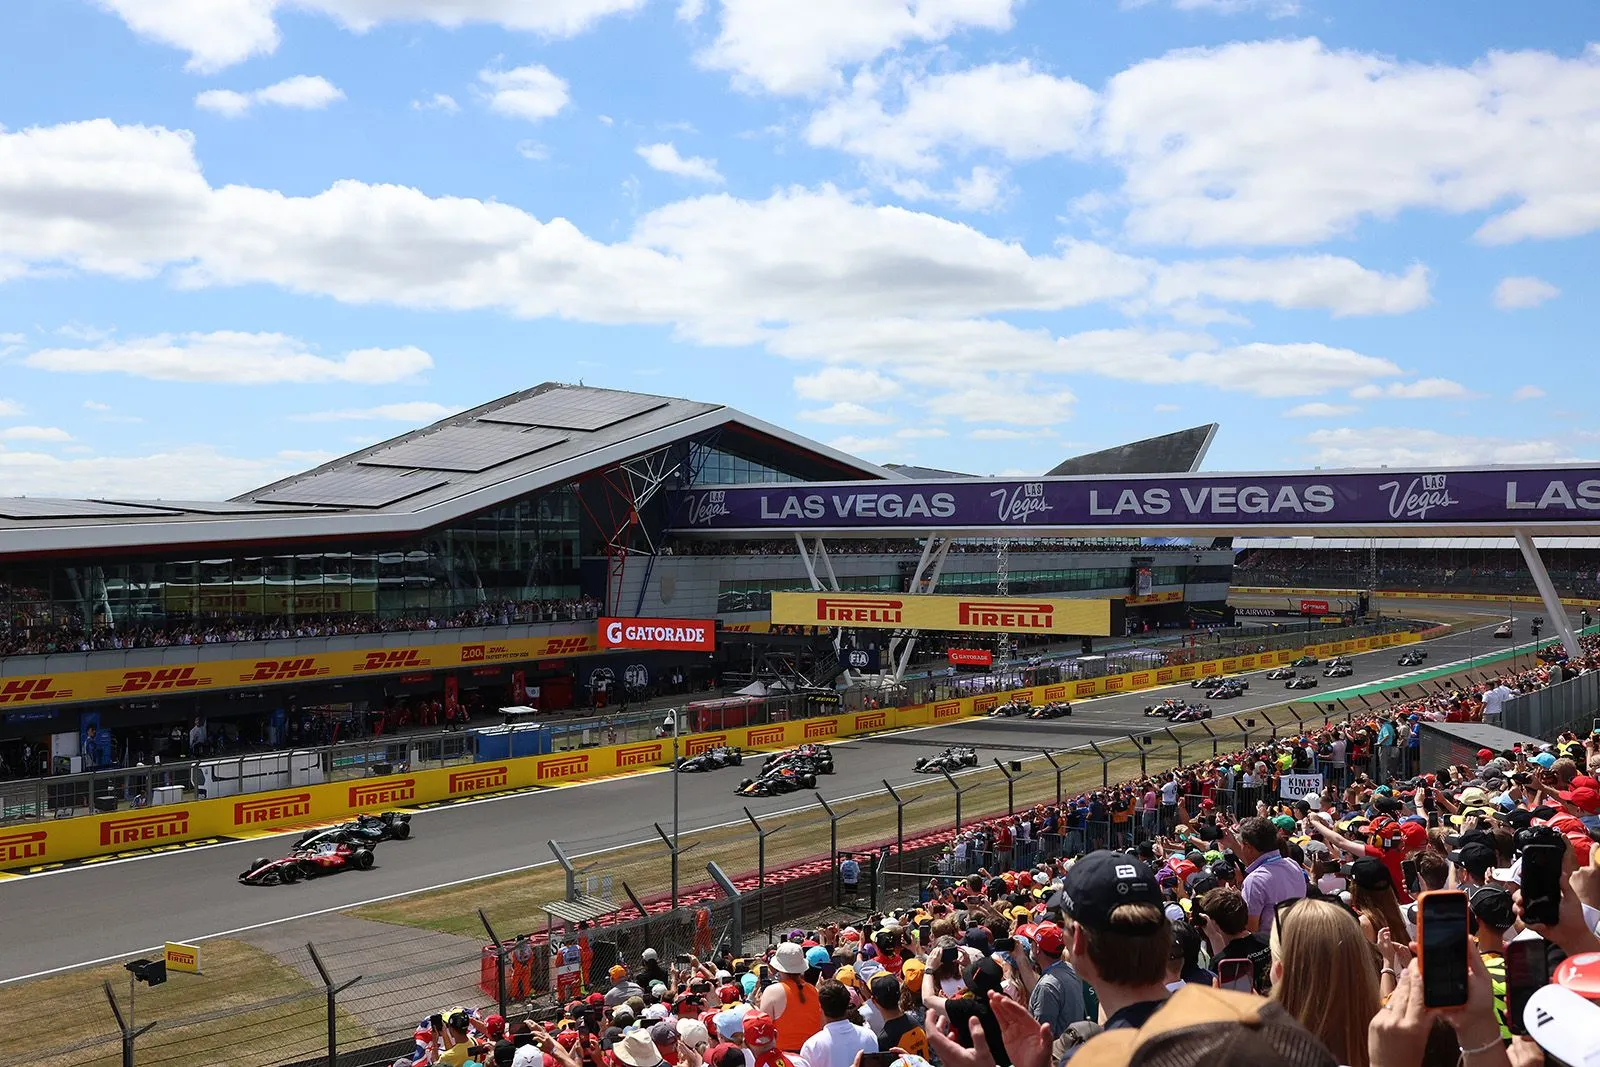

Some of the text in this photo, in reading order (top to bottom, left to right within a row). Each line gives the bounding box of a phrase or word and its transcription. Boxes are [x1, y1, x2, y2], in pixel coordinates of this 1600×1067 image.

[1025, 483, 1043, 496] LAS
[1424, 475, 1445, 490] LAS
[1505, 479, 1600, 510] LAS
[684, 491, 730, 525] Vegas
[710, 491, 725, 503] LAS
[760, 492, 956, 519] LAS VEGAS
[990, 486, 1053, 522] Vegas
[1090, 484, 1335, 516] LAS VEGAS
[1378, 478, 1459, 519] Vegas
[817, 598, 903, 623] PIRELLI
[959, 602, 1054, 628] PIRELLI
[546, 637, 589, 655] DHL
[625, 626, 705, 643] GATORADE
[252, 658, 318, 681] DHL
[364, 650, 421, 671] DHL
[0, 678, 57, 703] HL
[121, 667, 199, 692] DHL
[855, 712, 886, 730] PIRELLI
[934, 702, 960, 718] PIRELLI
[747, 727, 784, 746] PIRELLI
[804, 719, 838, 738] PIRELLI
[537, 755, 589, 780] PIRELLI
[616, 743, 662, 767] PIRELLI
[449, 766, 508, 794] PIRELLI
[349, 779, 416, 807] PIRELLI
[234, 793, 311, 825] PIRELLI
[100, 811, 190, 846] PIRELLI
[167, 951, 194, 965] PIRELLI
